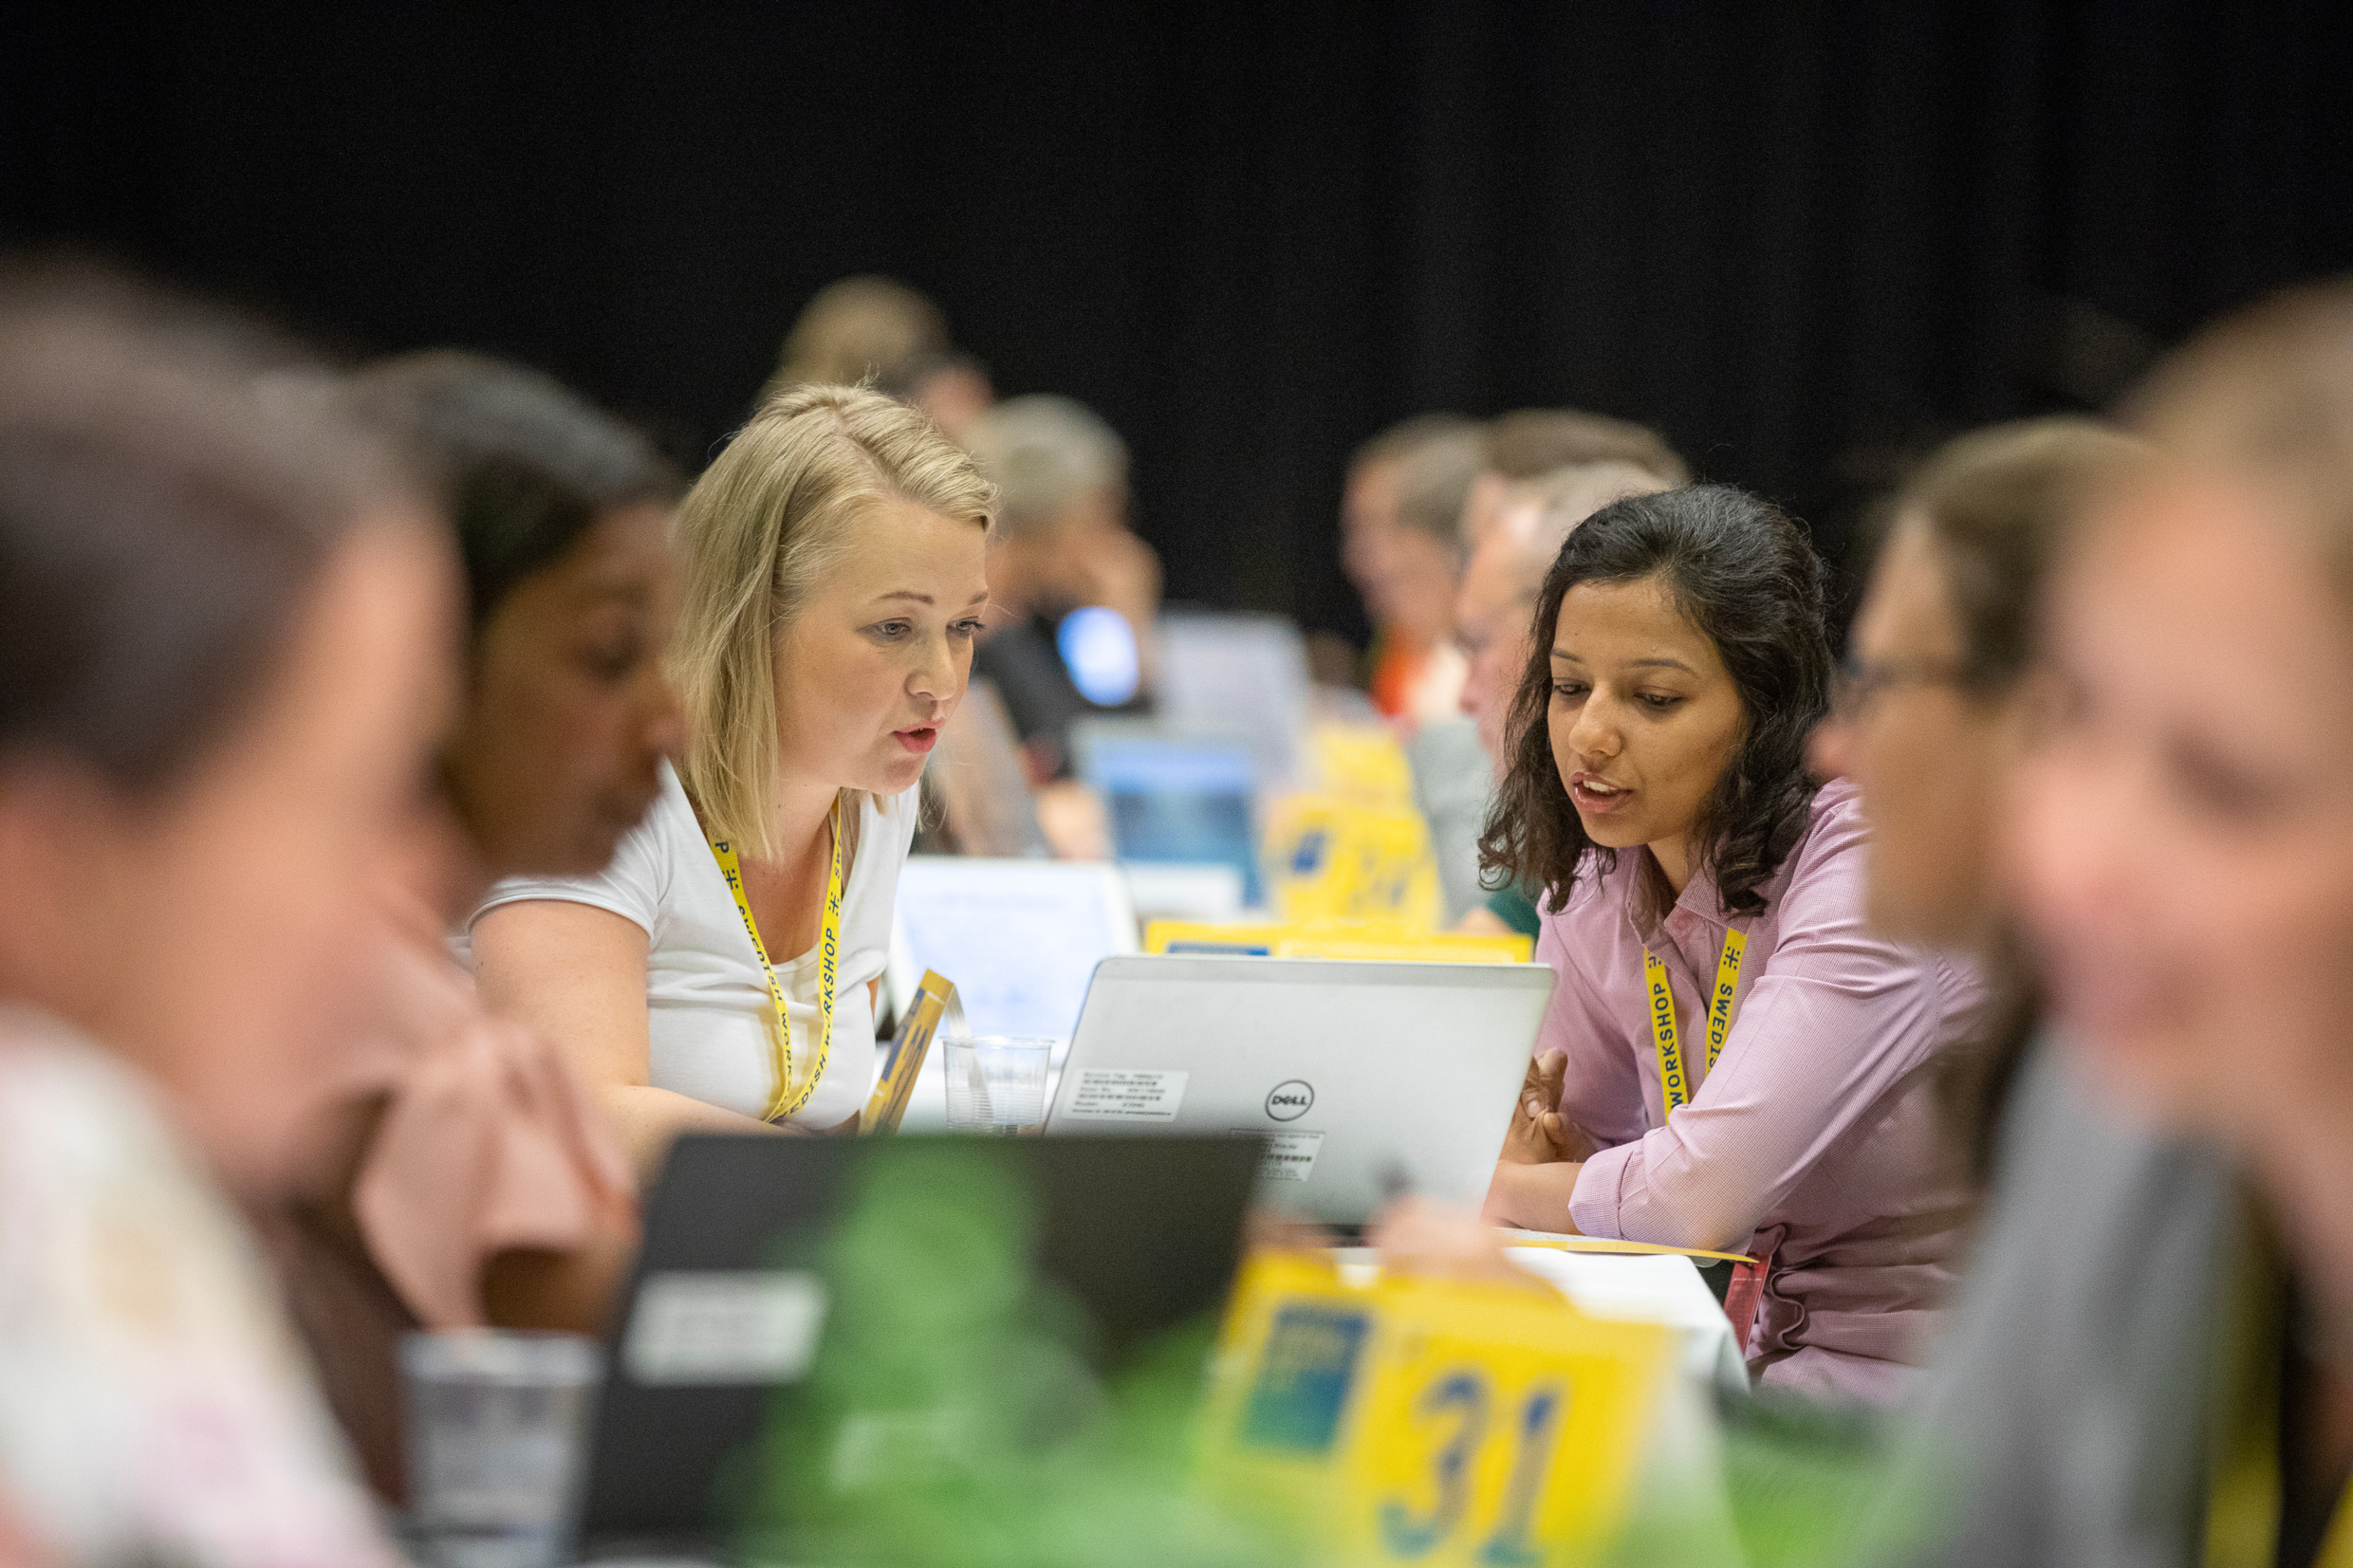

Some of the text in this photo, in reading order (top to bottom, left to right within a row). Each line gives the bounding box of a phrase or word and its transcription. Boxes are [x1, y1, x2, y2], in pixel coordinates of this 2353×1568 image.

[776, 927, 836, 1119] EDISH WRKSHOP
[1653, 983, 1683, 1108] WORKSHOP
[1708, 984, 1733, 1074] SWEDIS
[1271, 1095, 1308, 1106] DELL
[1380, 1364, 1557, 1566] 31
